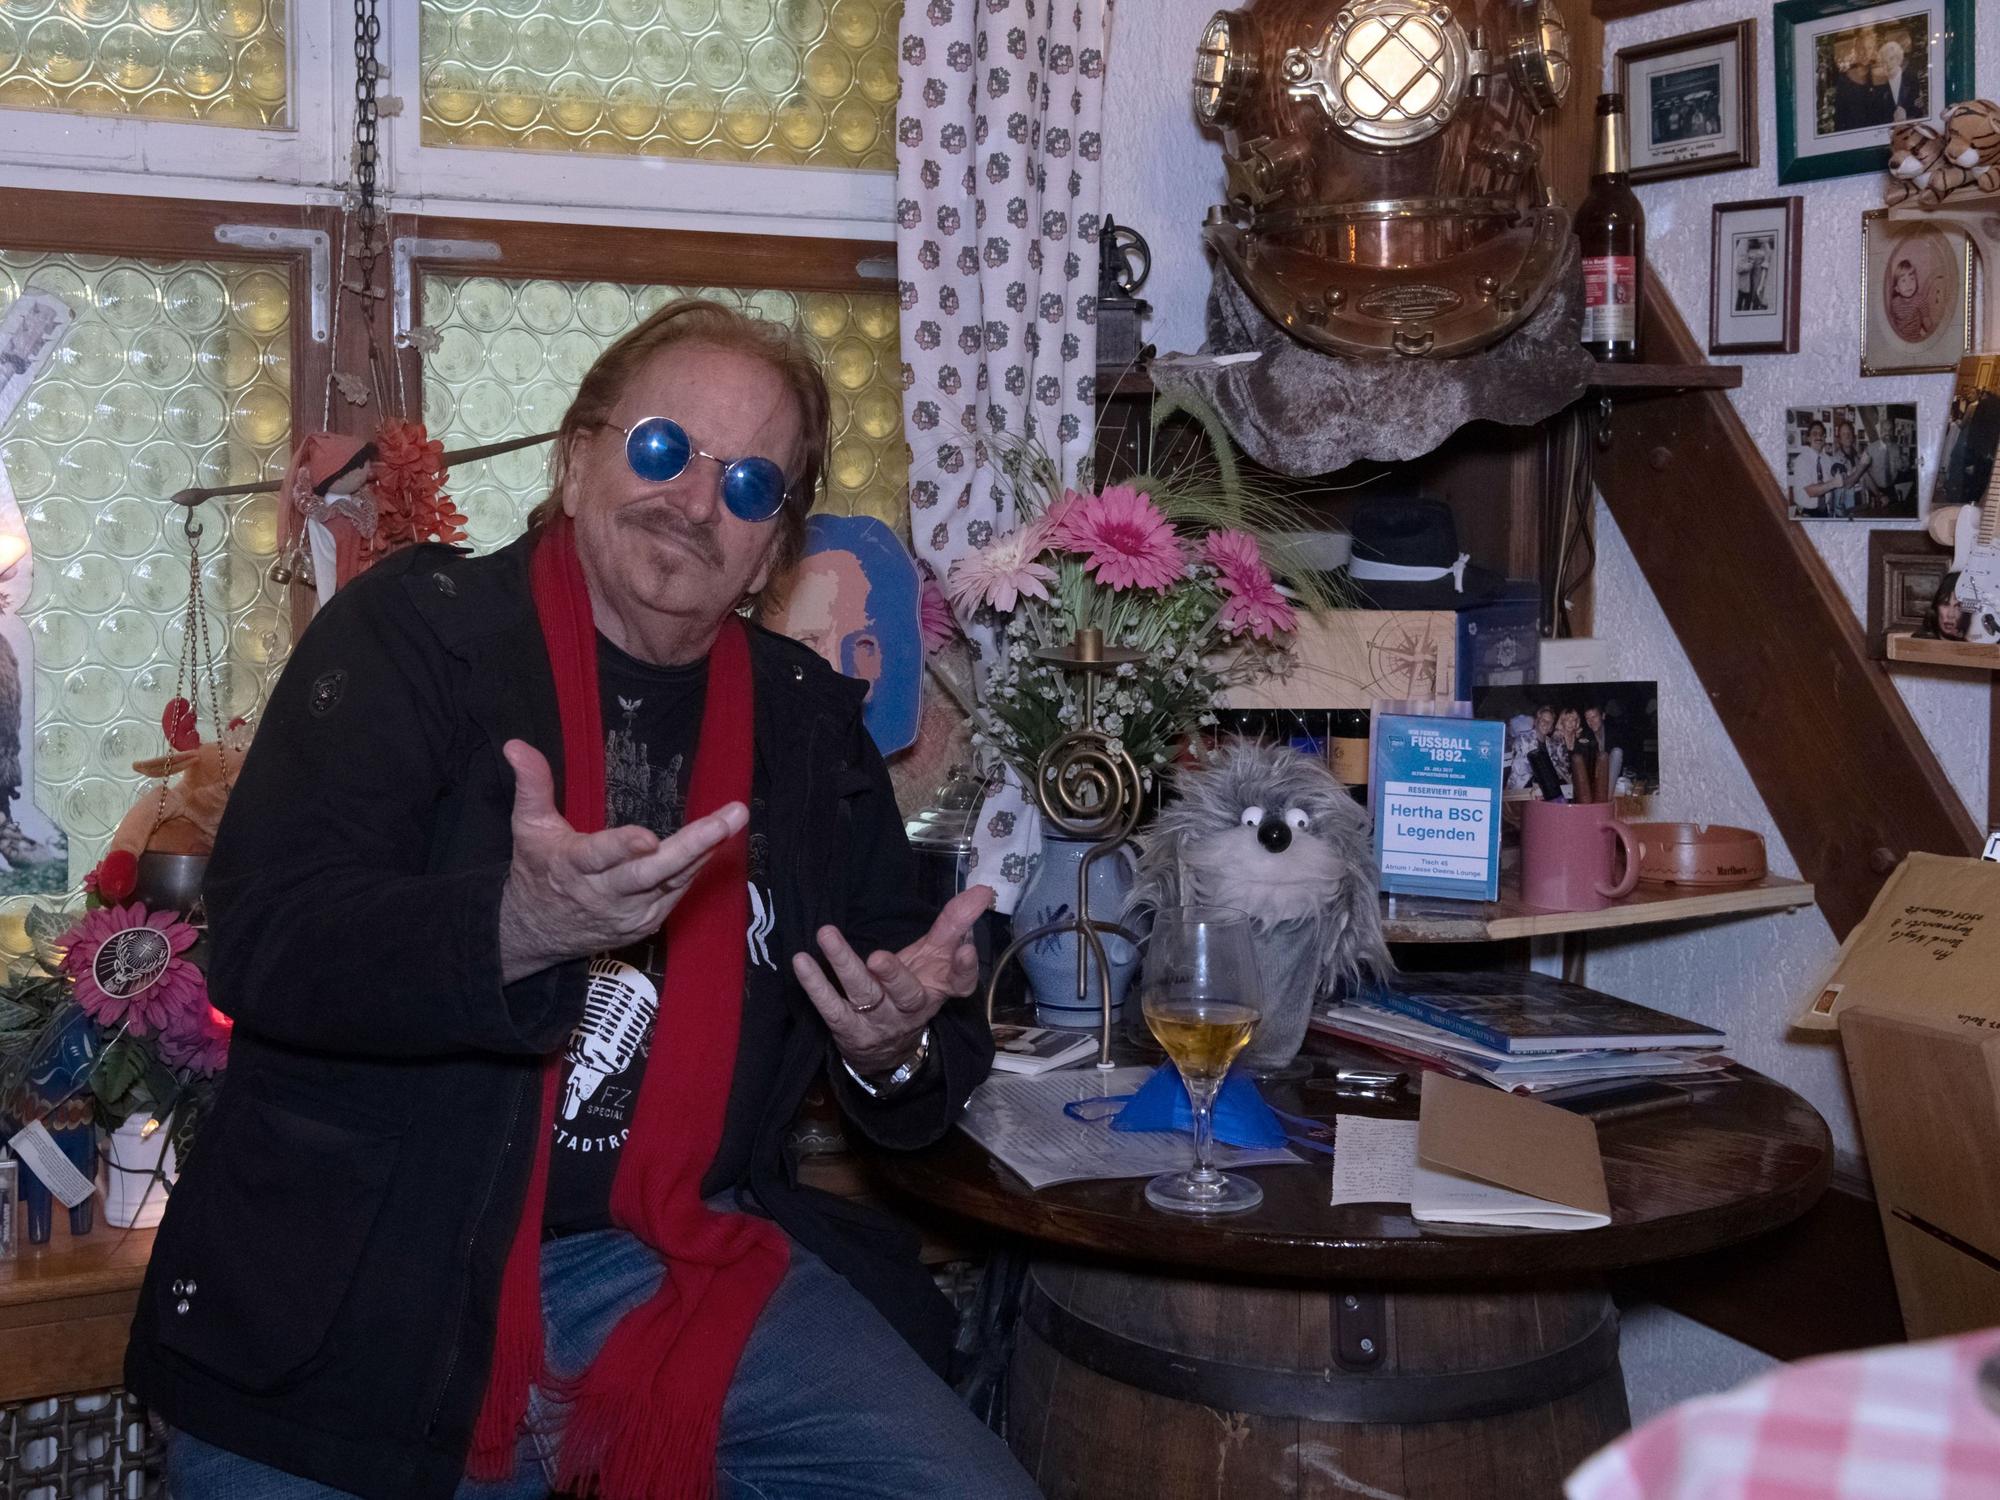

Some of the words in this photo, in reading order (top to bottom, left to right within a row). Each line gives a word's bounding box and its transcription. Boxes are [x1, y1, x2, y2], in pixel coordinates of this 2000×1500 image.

[1411, 736, 1473, 751] FUSSBALL
[1430, 749, 1467, 763] 1892.
[1408, 786, 1451, 796] RESERVIERT
[1454, 788, 1468, 797] FÜR
[1391, 804, 1443, 820] Hertha
[1449, 808, 1484, 822] BSC
[1397, 824, 1476, 841] Legenden
[1385, 863, 1407, 871] Atrium
[1432, 867, 1455, 875] Owens
[1456, 868, 1481, 877] Lounge
[1958, 1014, 1986, 1026] Berlin
[601, 1085, 632, 1108] FZ
[586, 1105, 624, 1120] SPECIAL
